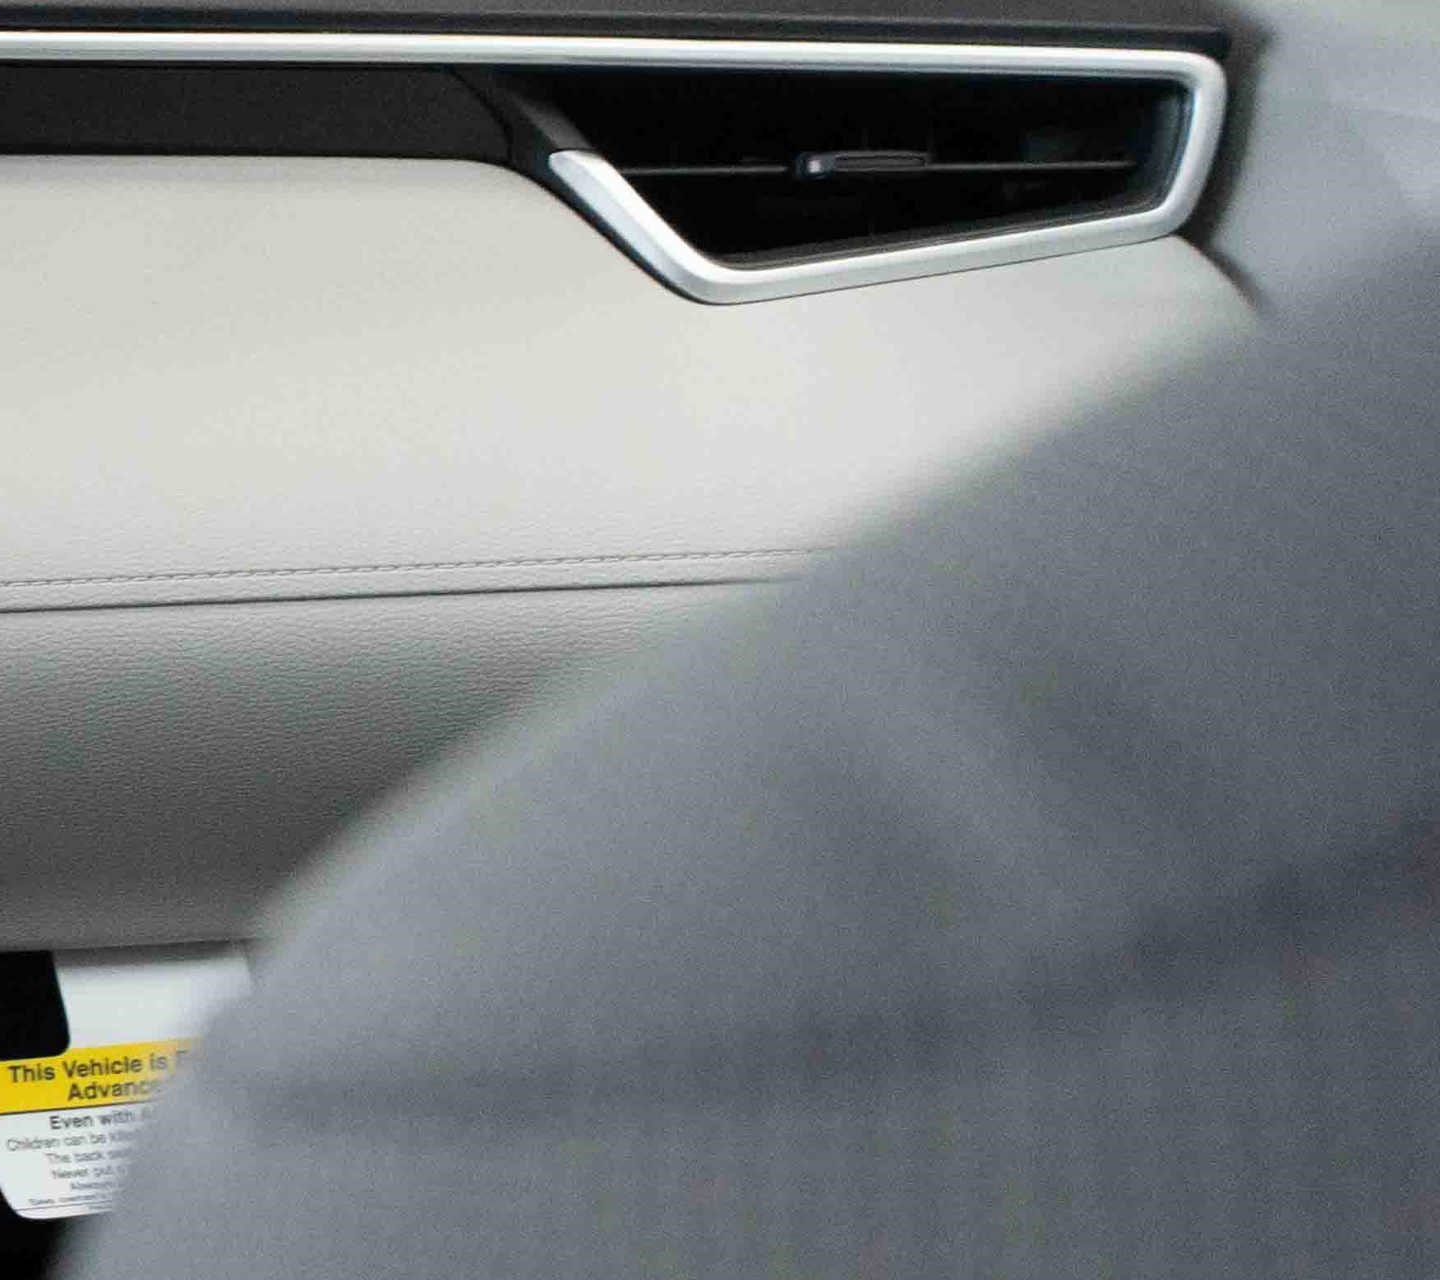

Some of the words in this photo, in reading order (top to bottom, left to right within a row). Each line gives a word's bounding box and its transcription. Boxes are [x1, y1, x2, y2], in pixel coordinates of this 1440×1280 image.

[7, 1062, 56, 1083] This
[61, 1056, 143, 1079] Vehicle
[149, 1052, 168, 1070] is
[49, 1115, 94, 1130] Even
[6, 1136, 61, 1152] Children
[64, 1135, 86, 1147] can
[46, 1152, 73, 1164] The
[52, 1169, 89, 1180] Never
